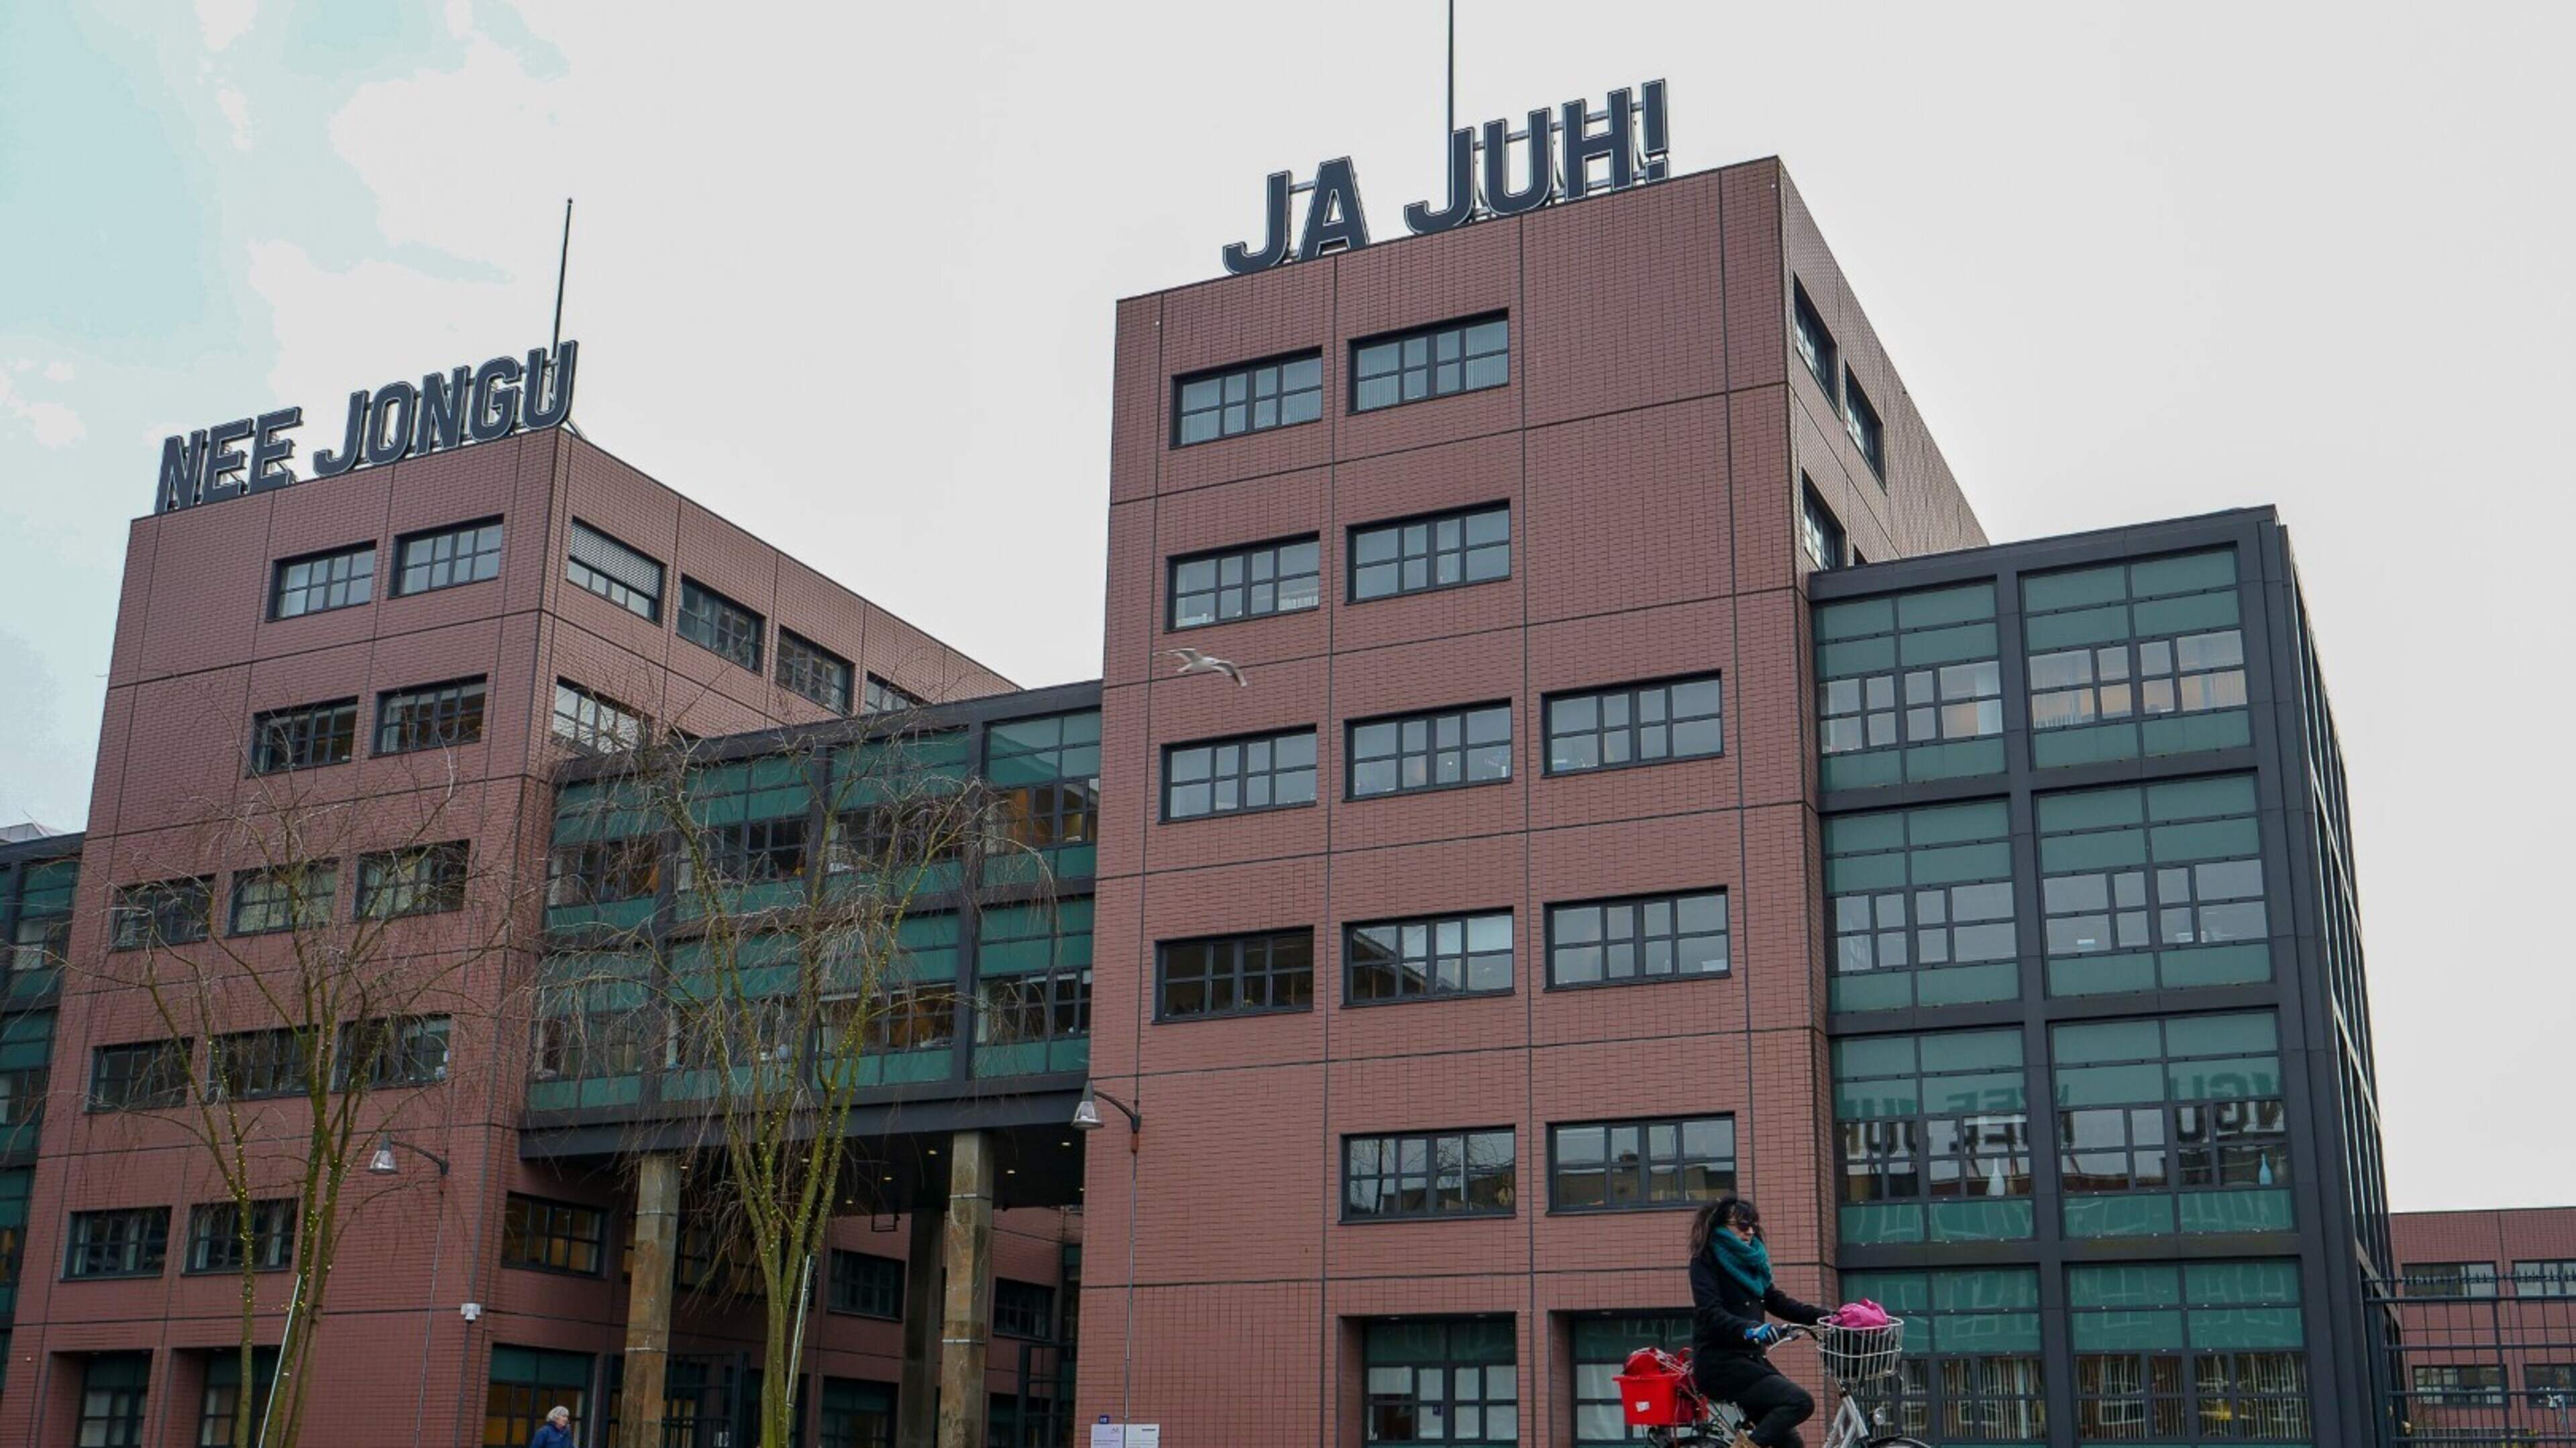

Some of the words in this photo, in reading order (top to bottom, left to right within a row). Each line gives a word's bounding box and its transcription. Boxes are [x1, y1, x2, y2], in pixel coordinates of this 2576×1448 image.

[1222, 155, 1371, 276] JA
[1403, 78, 1669, 235] JUH!
[155, 406, 303, 515] NEE
[313, 339, 578, 476] JONGU
